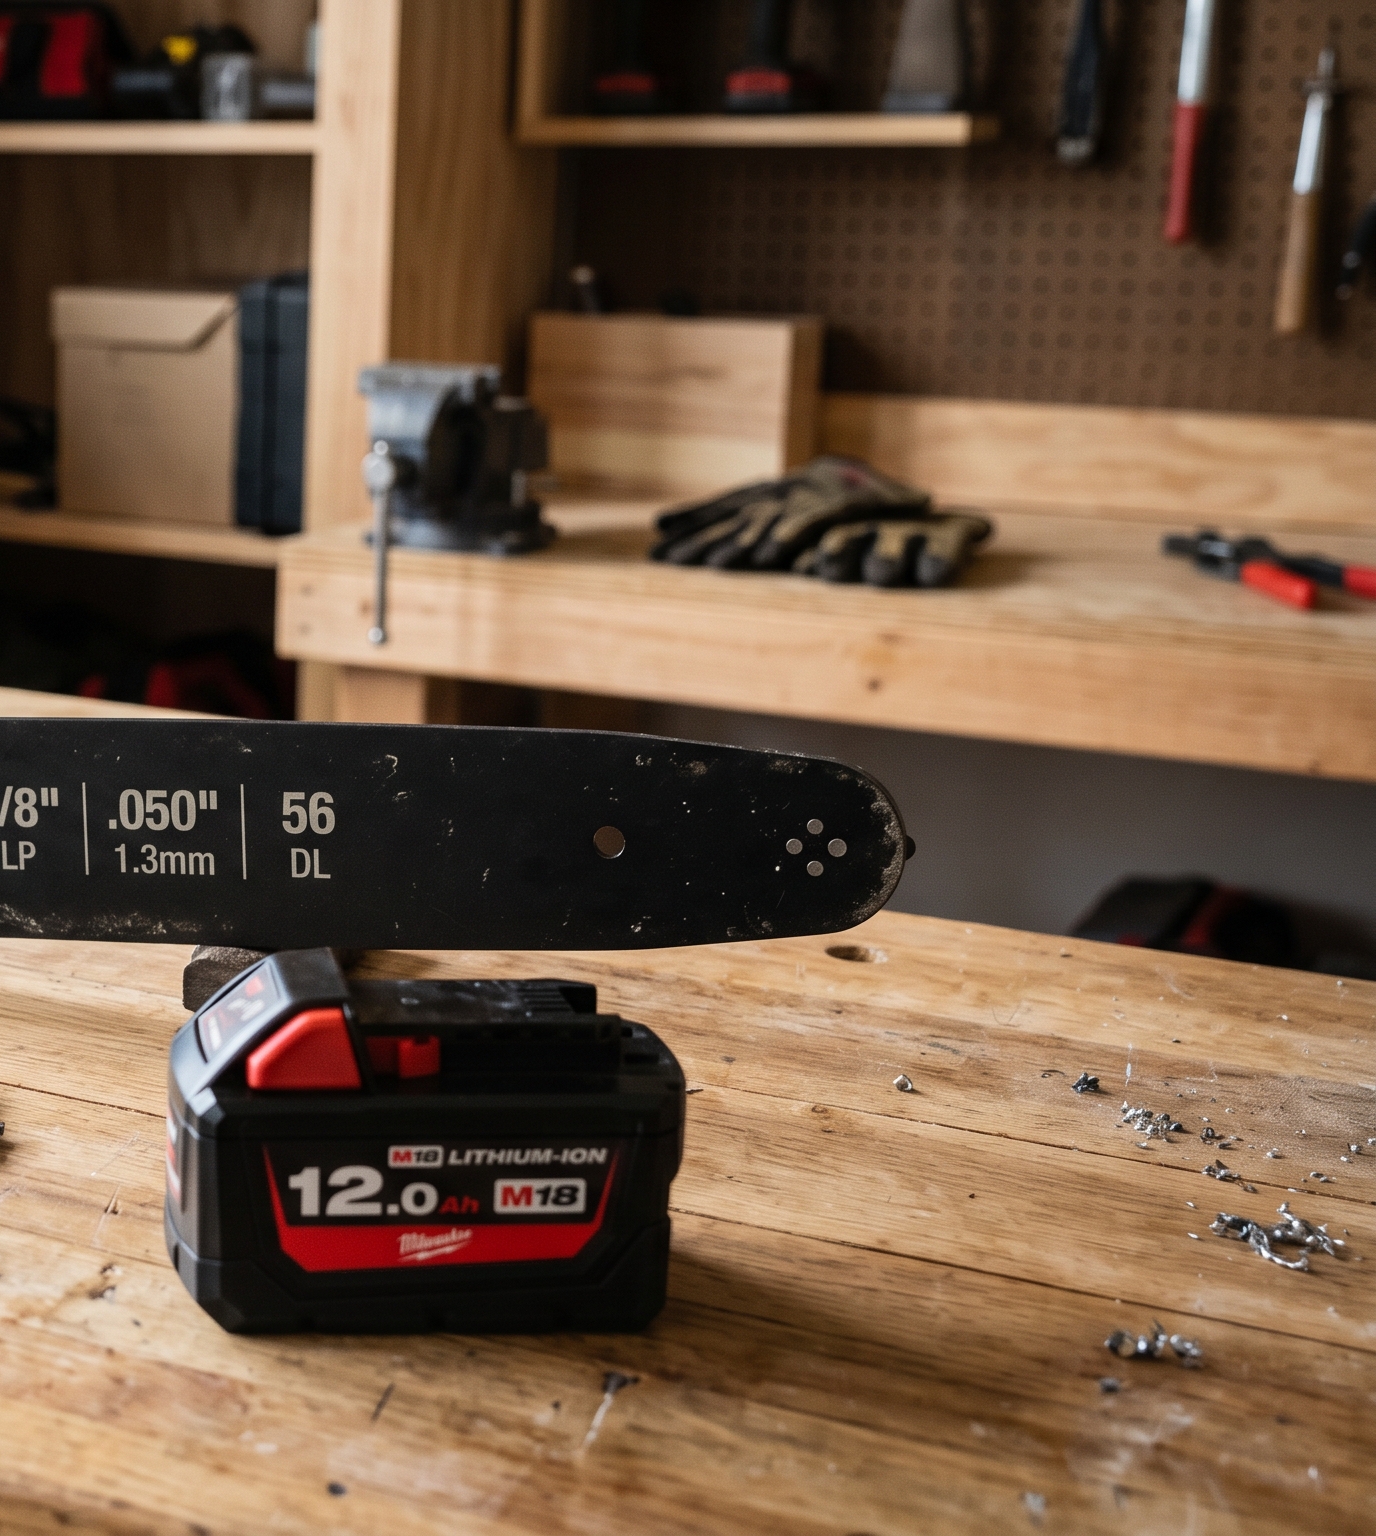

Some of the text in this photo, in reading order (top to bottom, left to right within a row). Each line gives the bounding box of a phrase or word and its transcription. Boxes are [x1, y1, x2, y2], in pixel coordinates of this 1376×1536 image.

[108, 789, 218, 832] .050"
[282, 792, 336, 834] 56
[2, 841, 36, 871] LP
[115, 844, 216, 876] 1.3mm
[291, 848, 331, 879] DL
[392, 1148, 607, 1165] M18 LITHIUM-ION
[501, 1185, 580, 1208] M18
